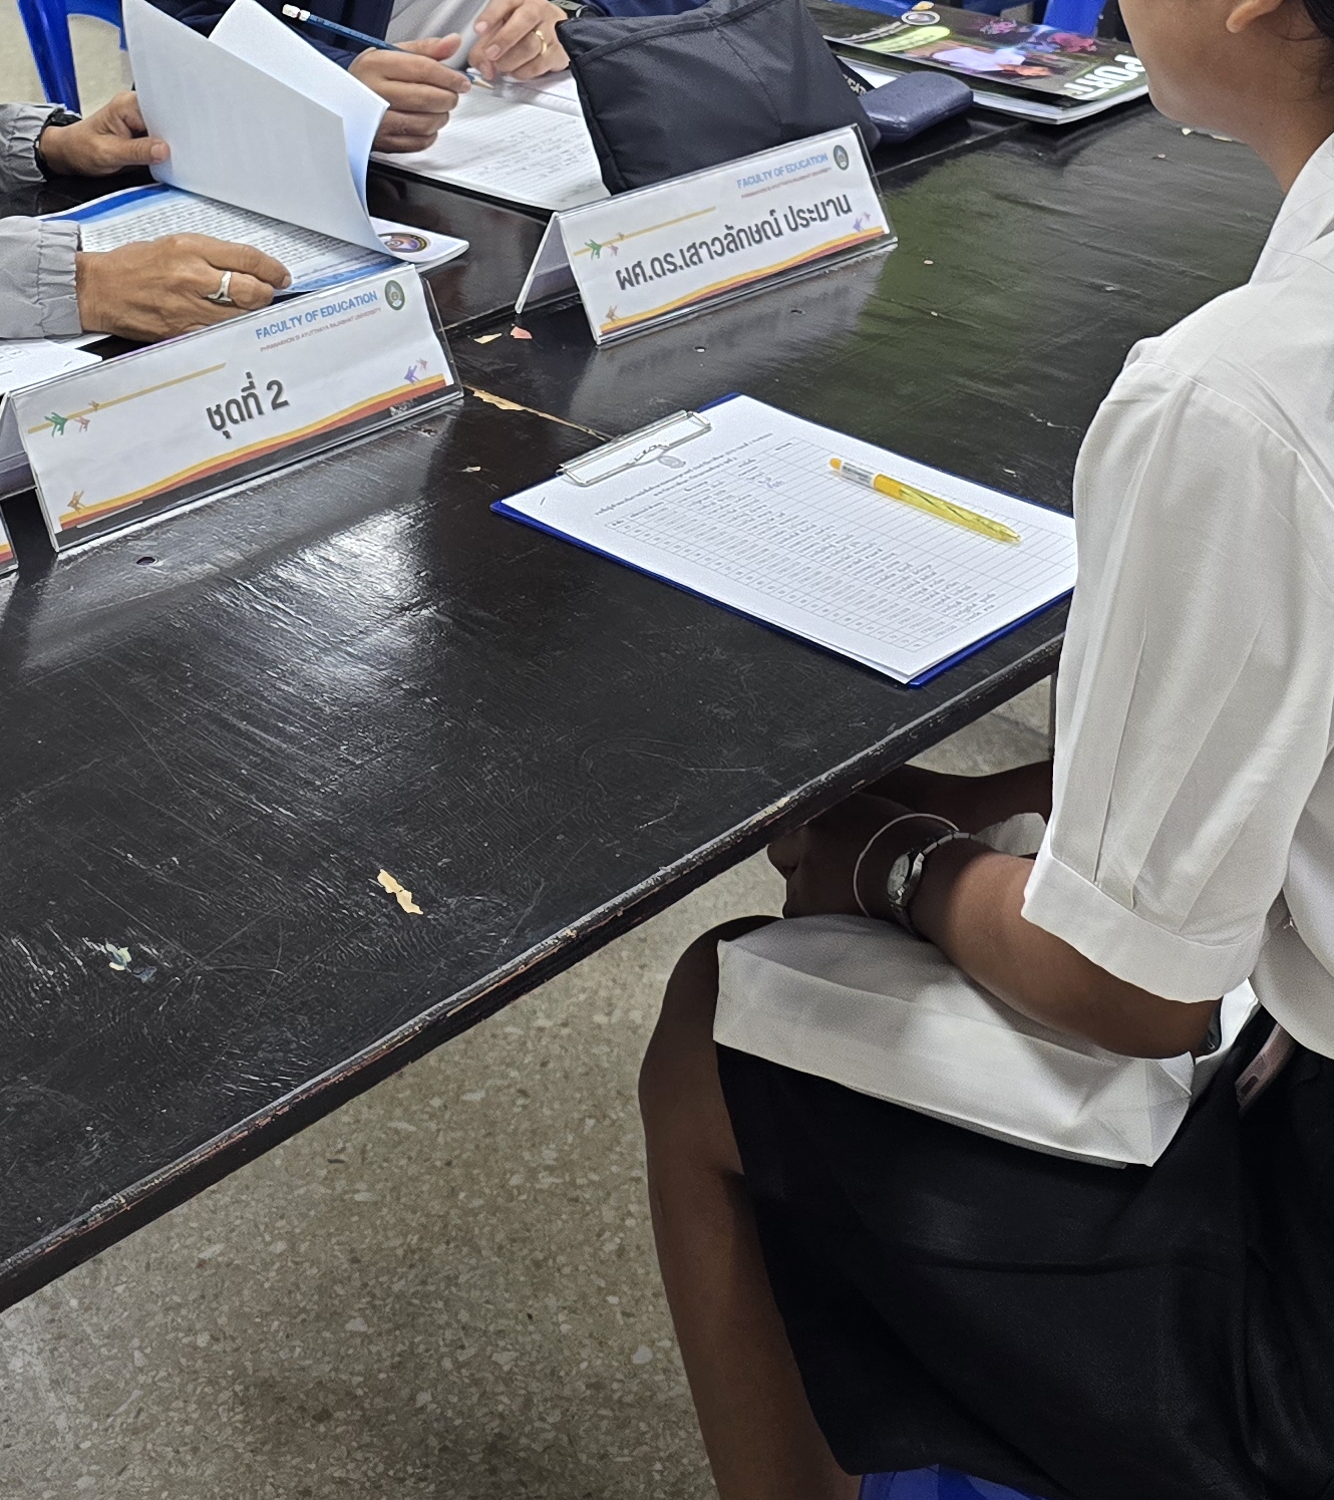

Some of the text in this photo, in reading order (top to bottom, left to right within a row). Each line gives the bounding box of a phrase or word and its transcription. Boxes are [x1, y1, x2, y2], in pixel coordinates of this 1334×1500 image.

[736, 169, 772, 189] FACULTY
[773, 165, 785, 177] OF
[786, 153, 828, 174] EDUCATION
[615, 194, 853, 290] ผศ.ดร.เสาวลักษณ์ ประมาน
[255, 290, 378, 340] FACULTY OF EDUCATION
[206, 371, 290, 439] ชุดที่ 2
